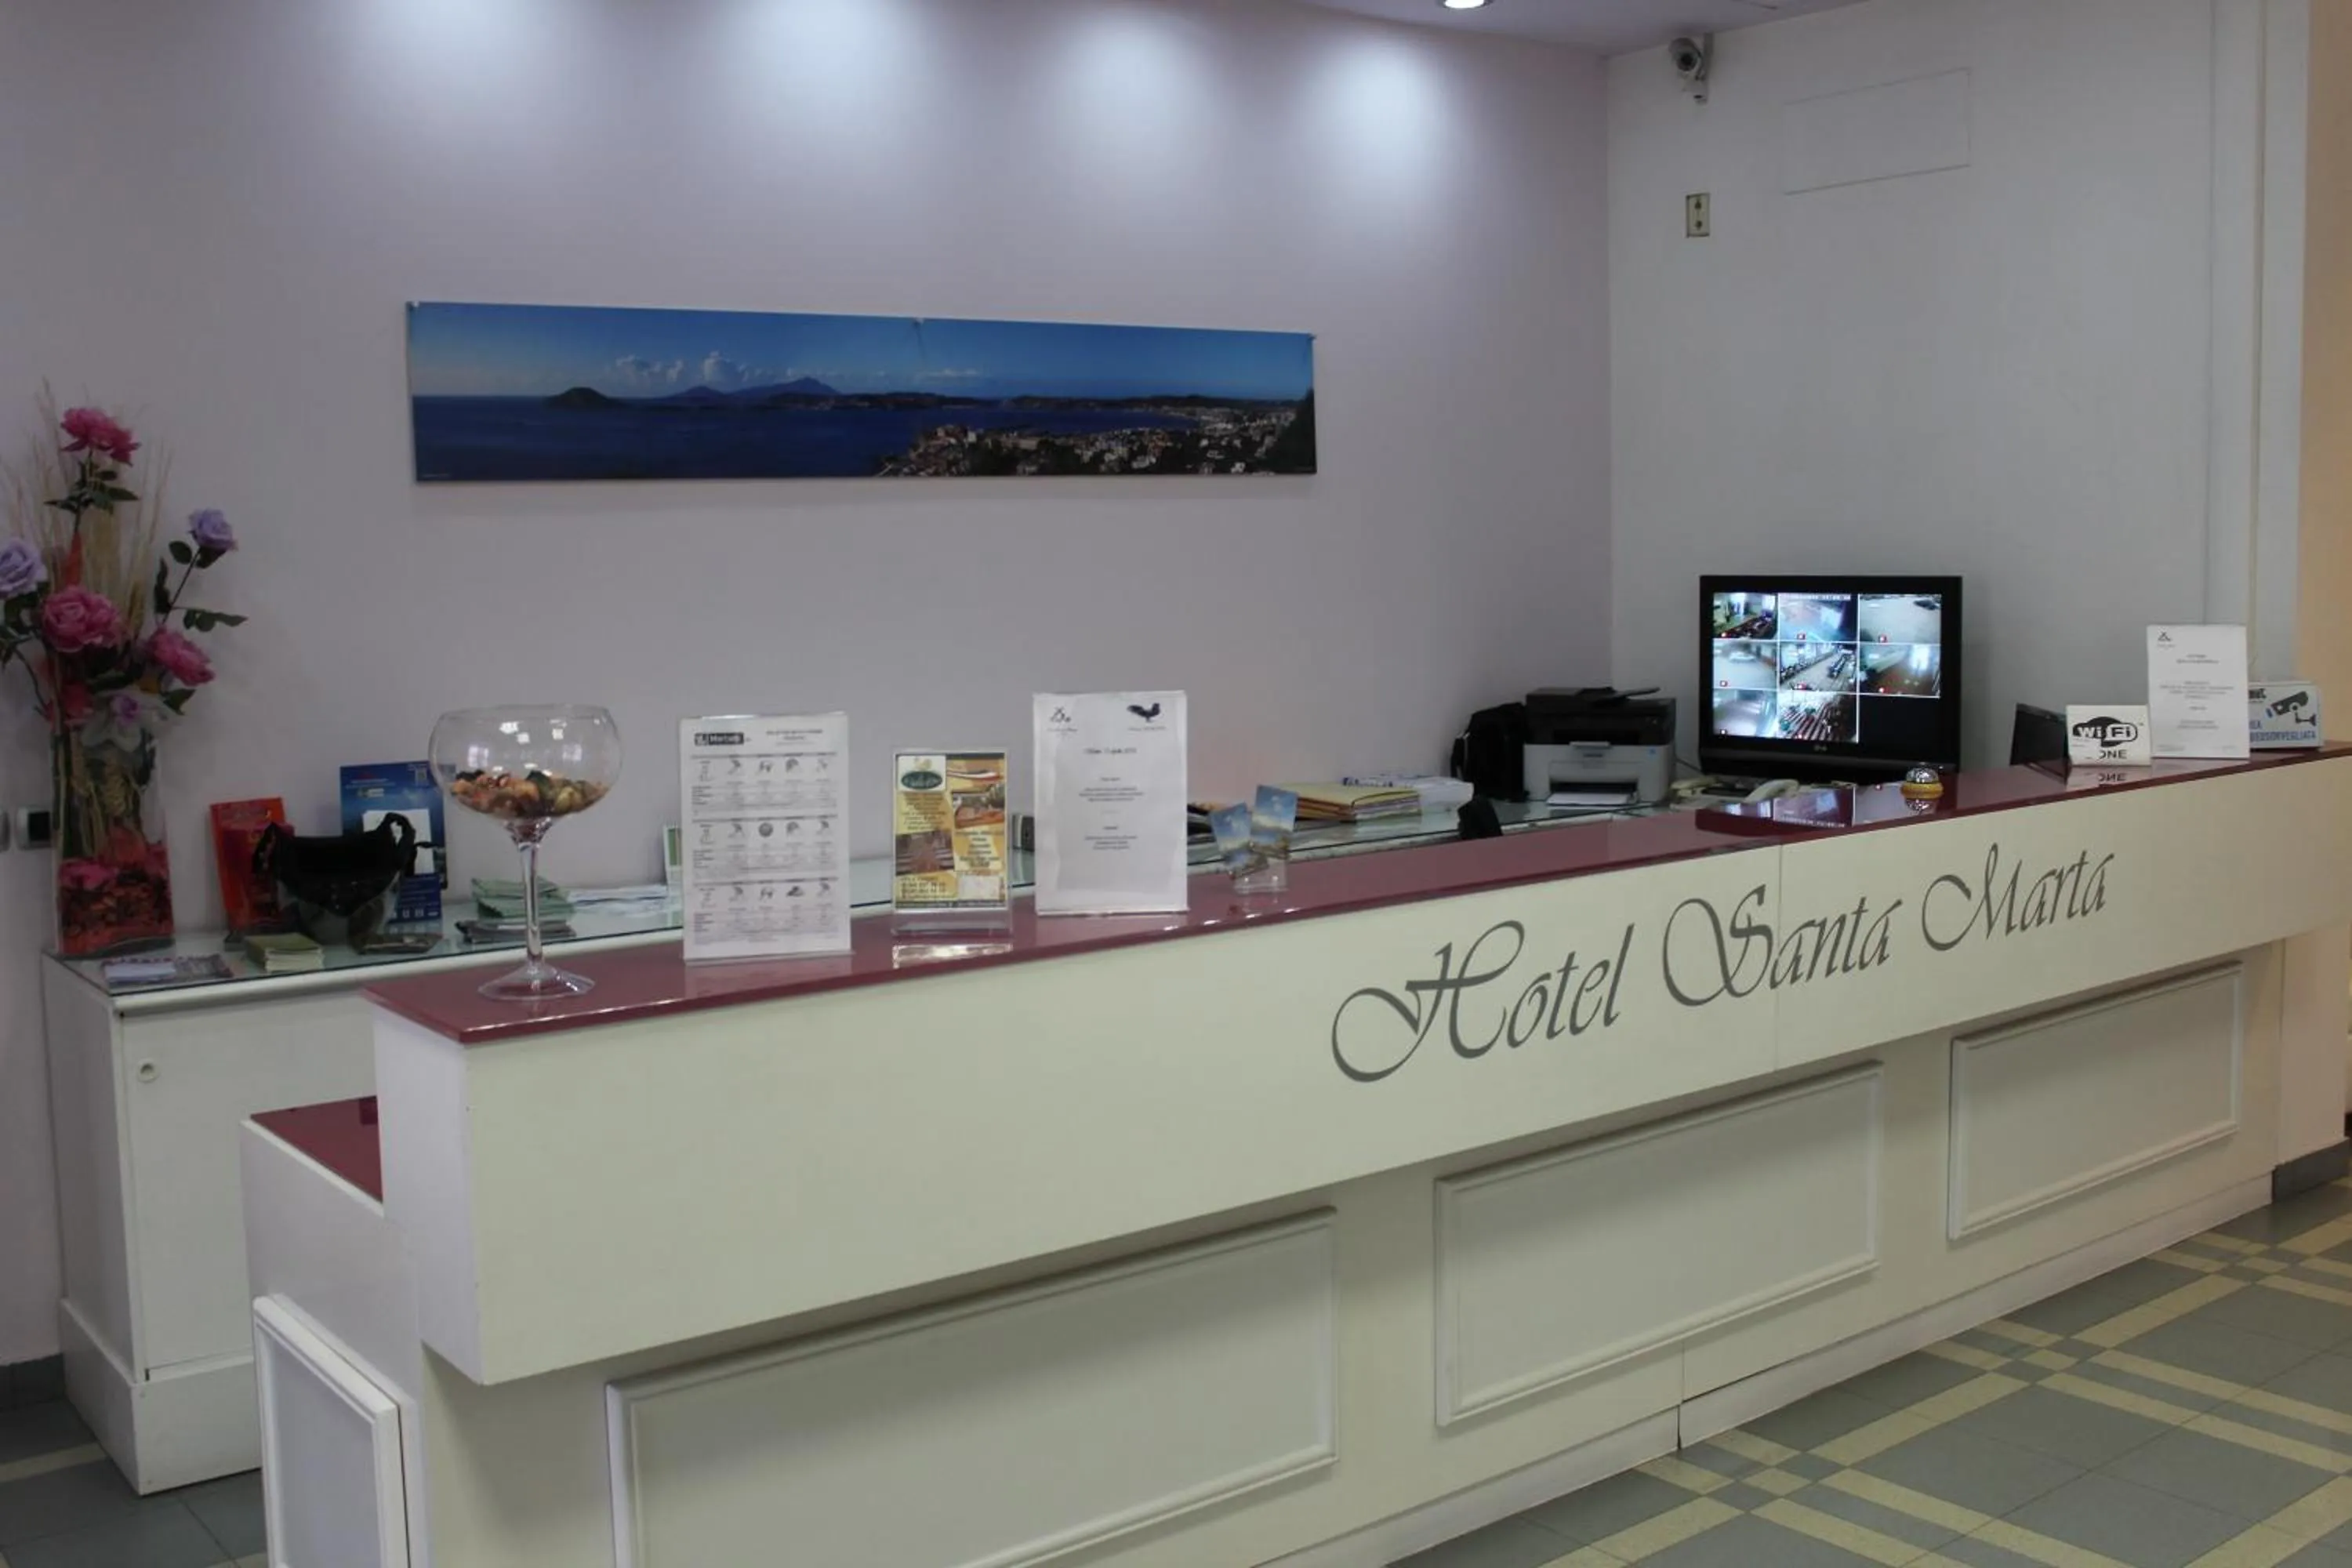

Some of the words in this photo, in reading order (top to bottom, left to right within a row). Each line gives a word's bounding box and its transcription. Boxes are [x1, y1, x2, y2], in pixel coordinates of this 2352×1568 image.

[1332, 920, 1634, 1083] Hotel
[1663, 884, 1903, 1007] Santa
[1922, 842, 2114, 951] Marta
